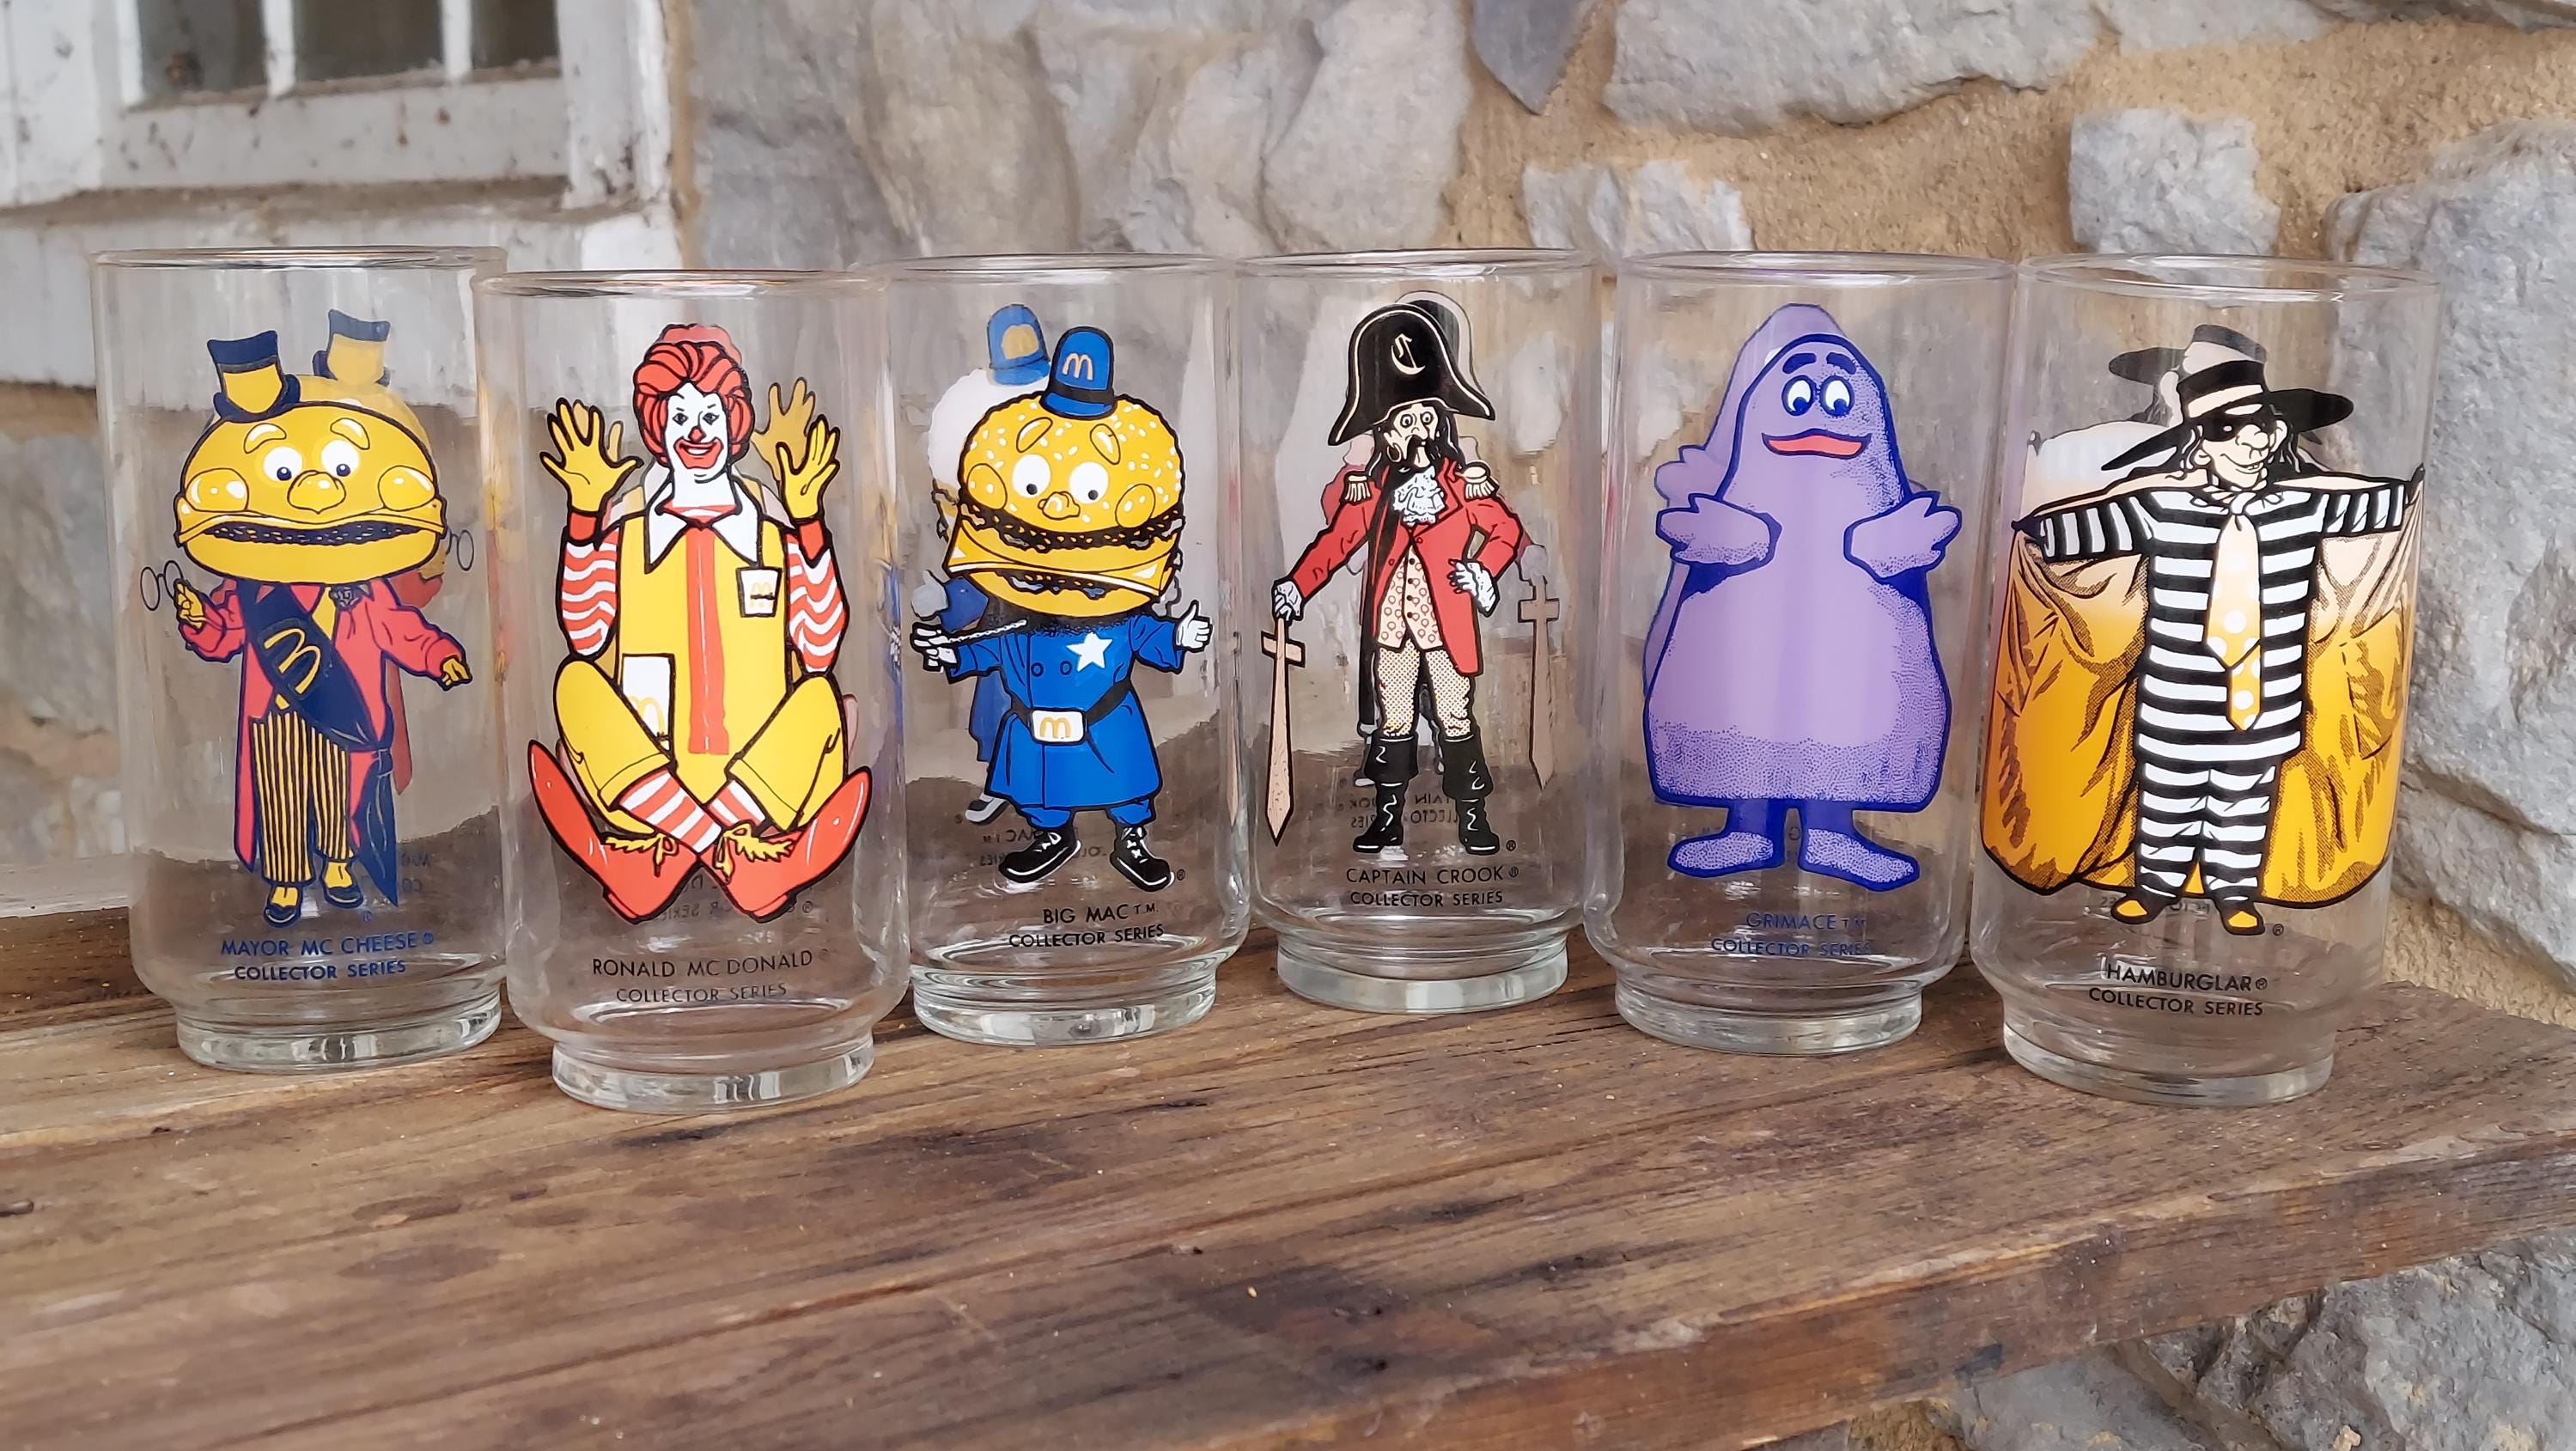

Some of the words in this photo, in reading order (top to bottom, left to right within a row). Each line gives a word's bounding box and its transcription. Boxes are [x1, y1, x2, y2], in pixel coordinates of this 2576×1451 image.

[1346, 867, 1427, 885] CAPTAIN
[1349, 891, 1444, 908] COLLECTOR
[1452, 890, 1503, 905] SERIES
[1043, 908, 1075, 924] BIG
[1086, 904, 1129, 924] MAC
[1746, 911, 1836, 930] GRIMACE
[1009, 931, 1106, 948] COLLECTOR
[1114, 924, 1165, 943] SERIES
[220, 939, 289, 956] MAYOR
[301, 939, 333, 956] MC
[1711, 937, 1810, 957] COLLECTOR
[1818, 943, 1872, 957] SERIES
[234, 965, 338, 981] COLLECTOR
[347, 959, 406, 979] SERIES
[593, 958, 675, 978] RONALD
[686, 960, 720, 977] MC
[727, 949, 813, 975] DONALD
[616, 988, 719, 1003] COLLECTOR
[729, 982, 788, 1001] SERIES
[2088, 987, 2195, 1014] COLLECTOR
[2204, 1001, 2263, 1016] SERIES
